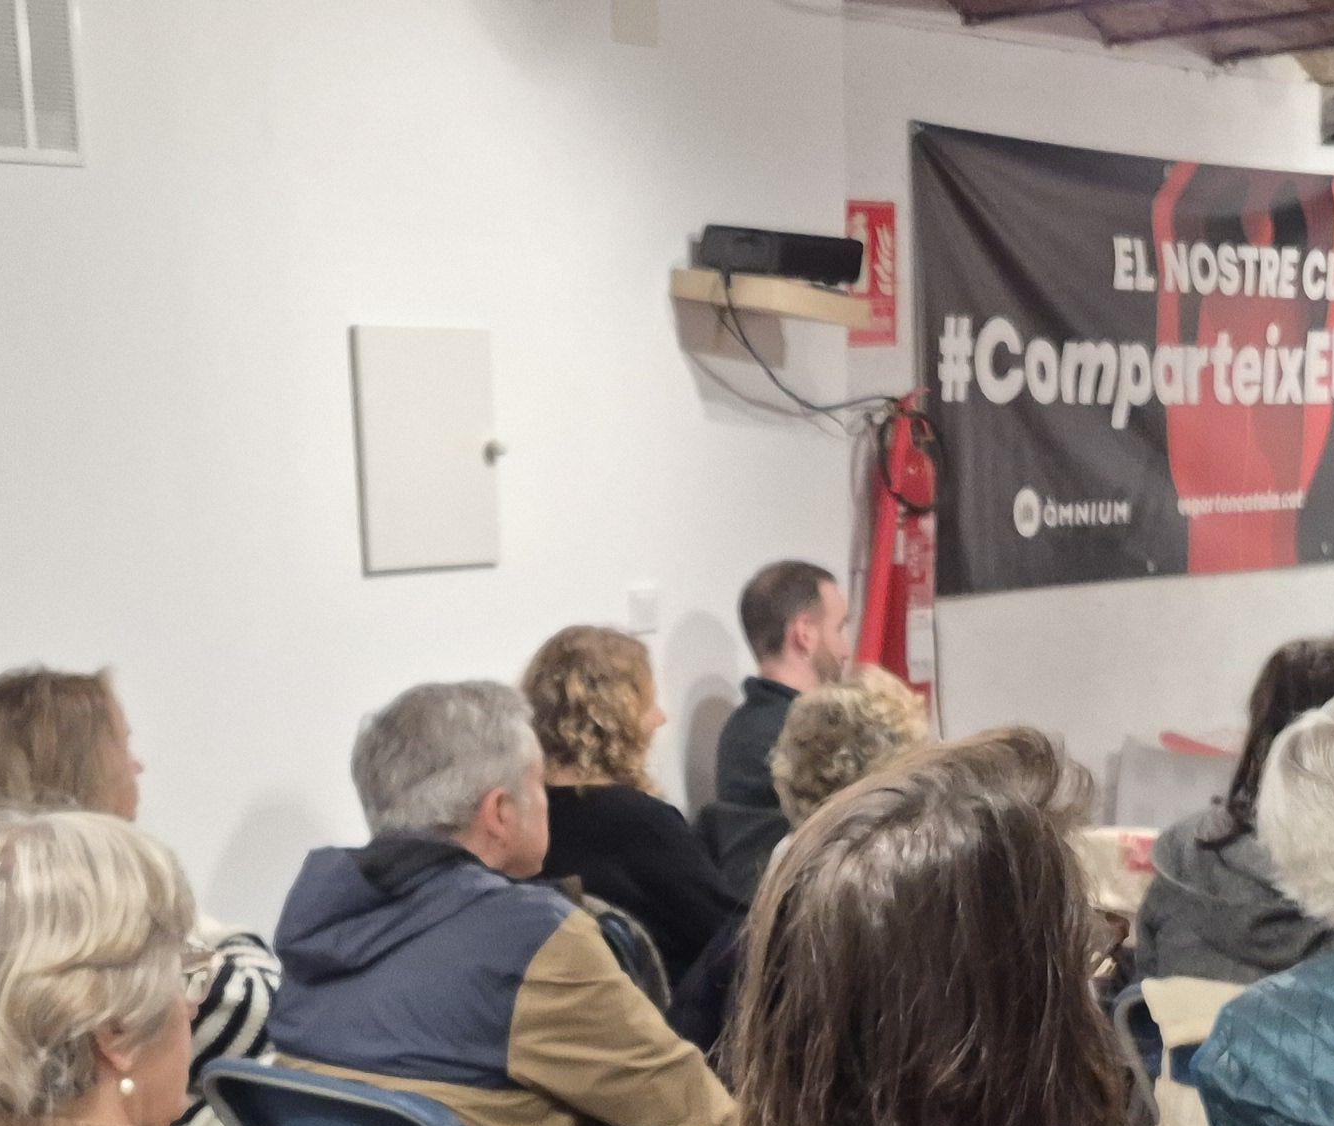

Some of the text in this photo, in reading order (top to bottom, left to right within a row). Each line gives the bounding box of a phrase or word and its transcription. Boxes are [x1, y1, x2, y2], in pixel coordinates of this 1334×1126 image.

[1113, 235, 1156, 292] EL
[1161, 240, 1301, 299] NOSTRE
[1043, 496, 1132, 528] ÒMNIUM
